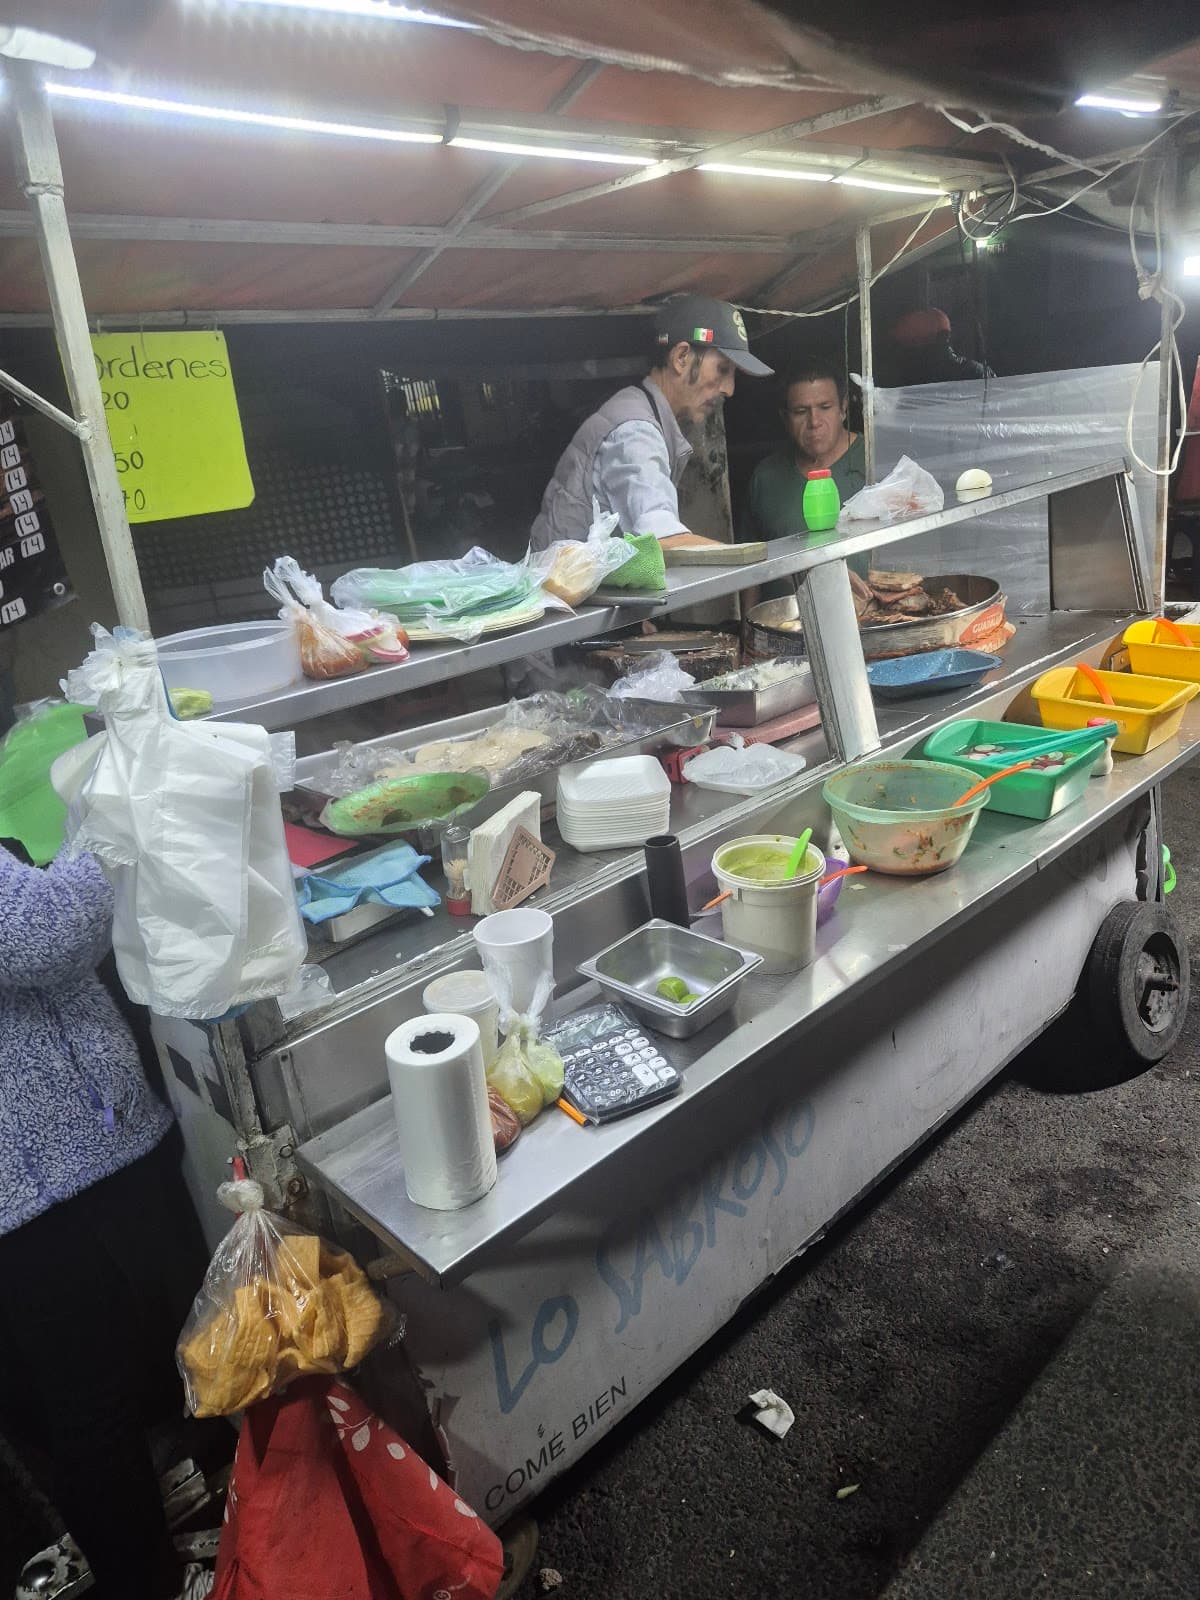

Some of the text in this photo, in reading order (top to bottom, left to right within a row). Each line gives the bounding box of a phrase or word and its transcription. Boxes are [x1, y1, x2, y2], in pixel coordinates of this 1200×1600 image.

[2, 447, 18, 467] 14
[7, 470, 22, 490] 14
[12, 494, 29, 513] 14
[17, 514, 36, 535] 14
[22, 535, 41, 555] 14
[4, 602, 20, 621] 14
[487, 1296, 579, 1414] LO
[572, 1375, 627, 1440] BIEN
